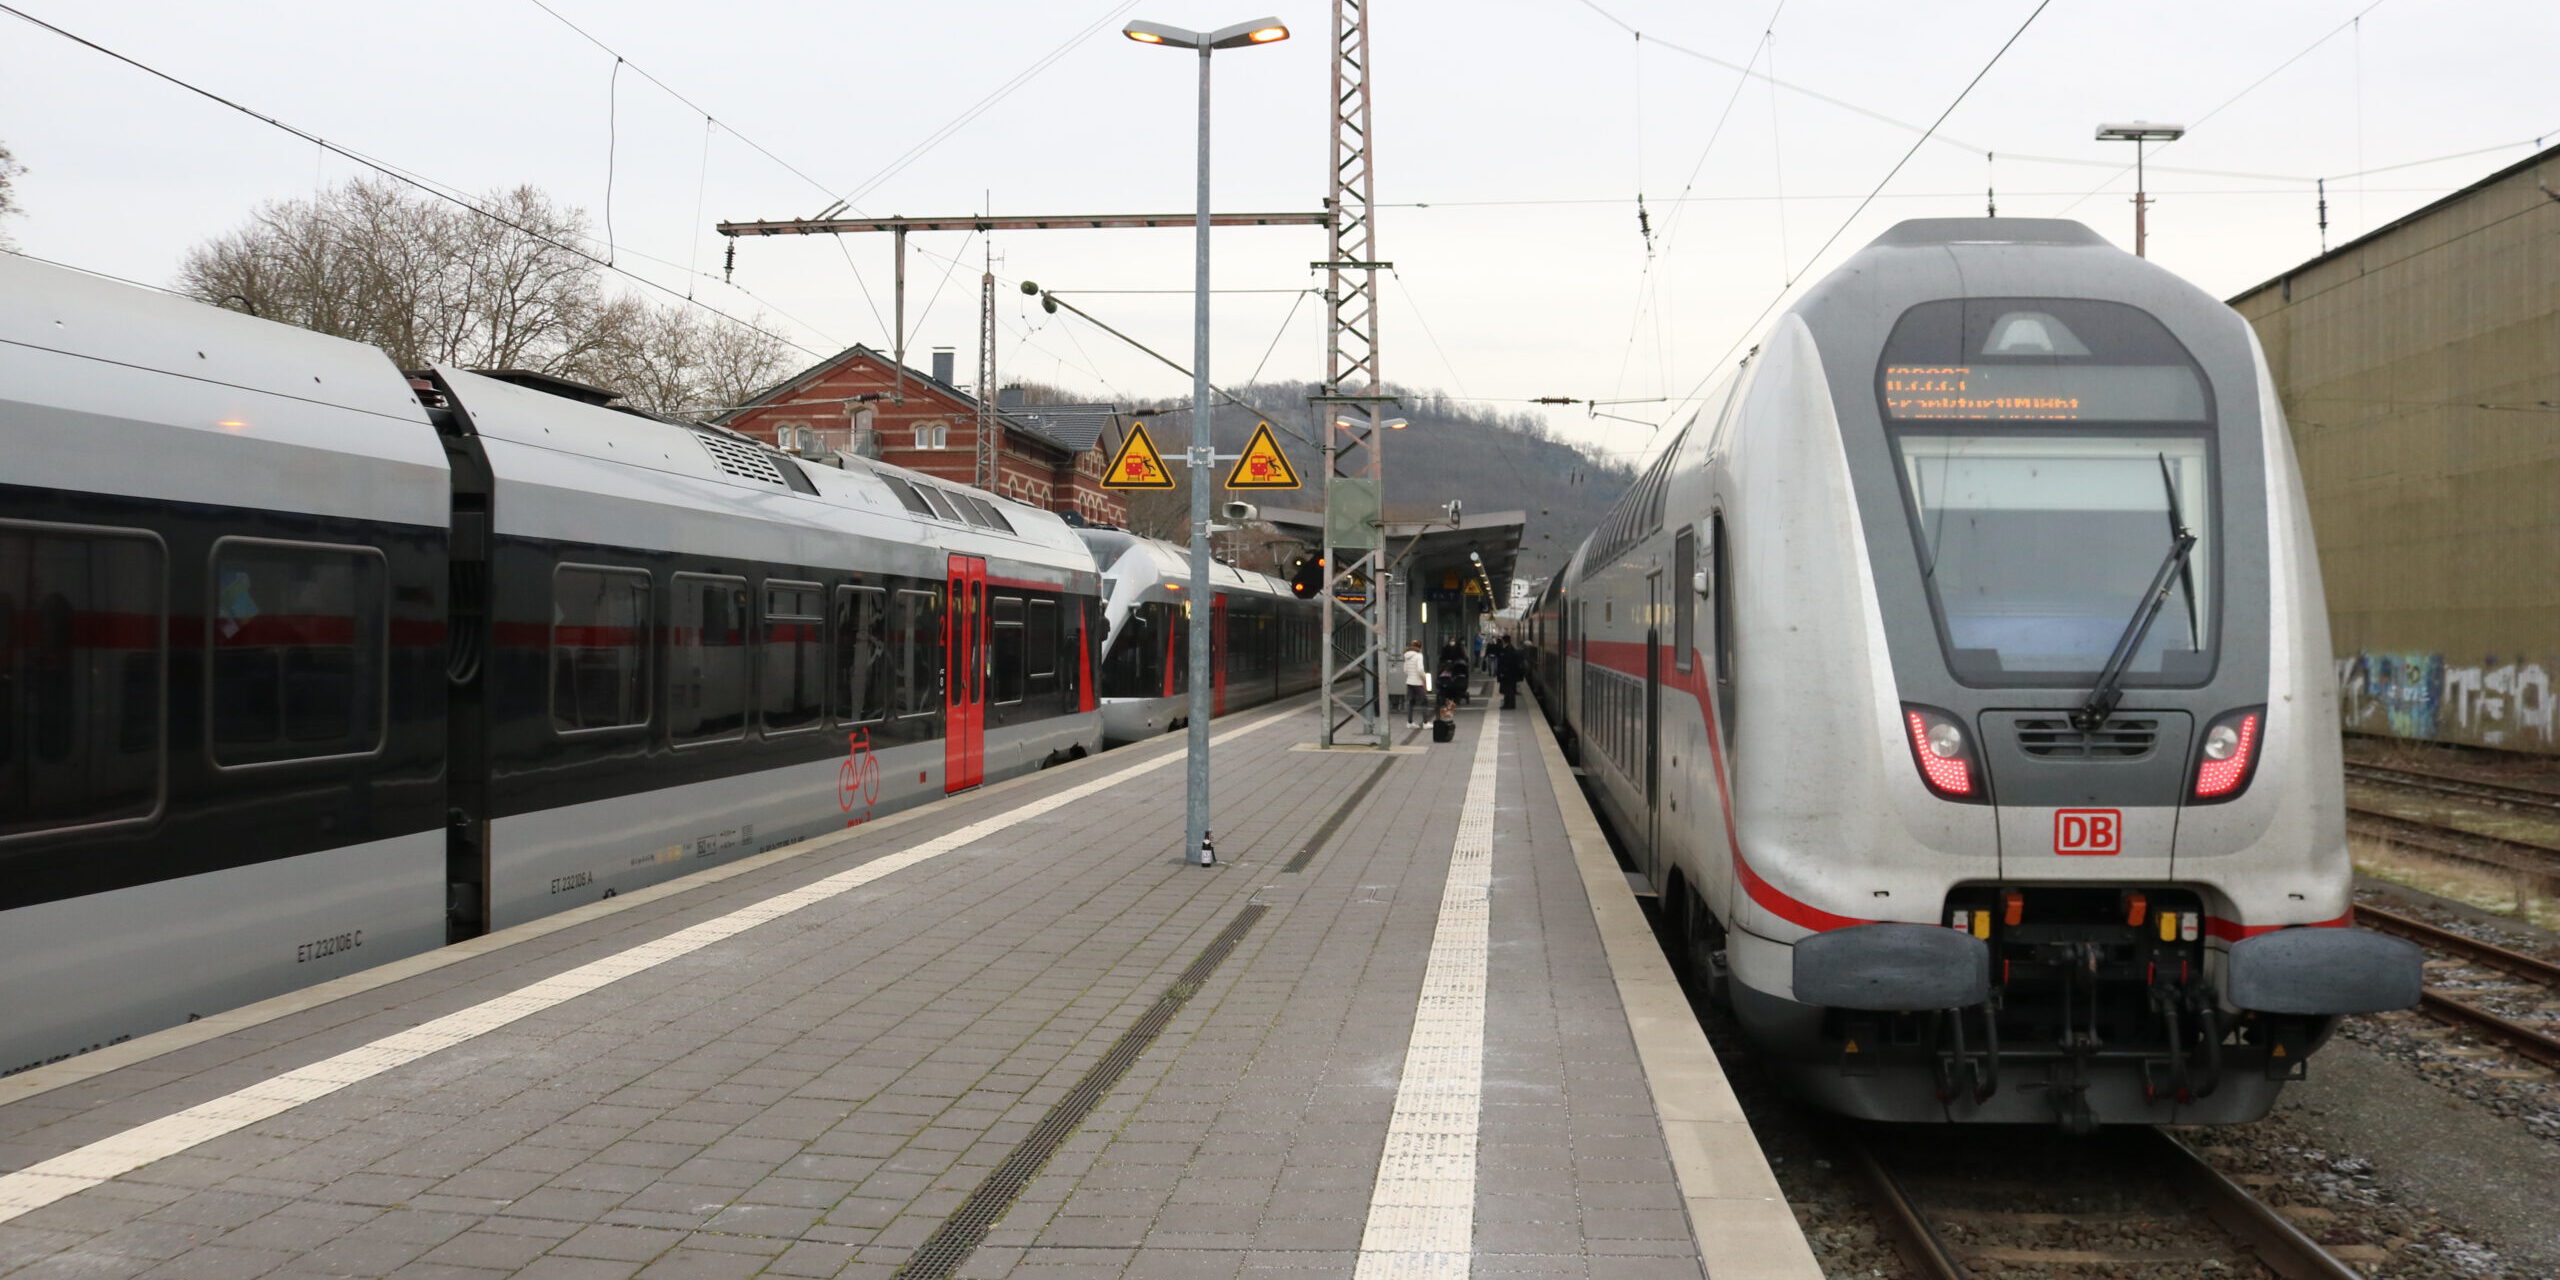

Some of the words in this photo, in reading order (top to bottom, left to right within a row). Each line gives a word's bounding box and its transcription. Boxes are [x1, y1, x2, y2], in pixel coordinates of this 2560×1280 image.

[2063, 816, 2113, 847] DB
[298, 943, 313, 962] ET
[315, 932, 352, 959] 232106
[355, 930, 363, 947] C
